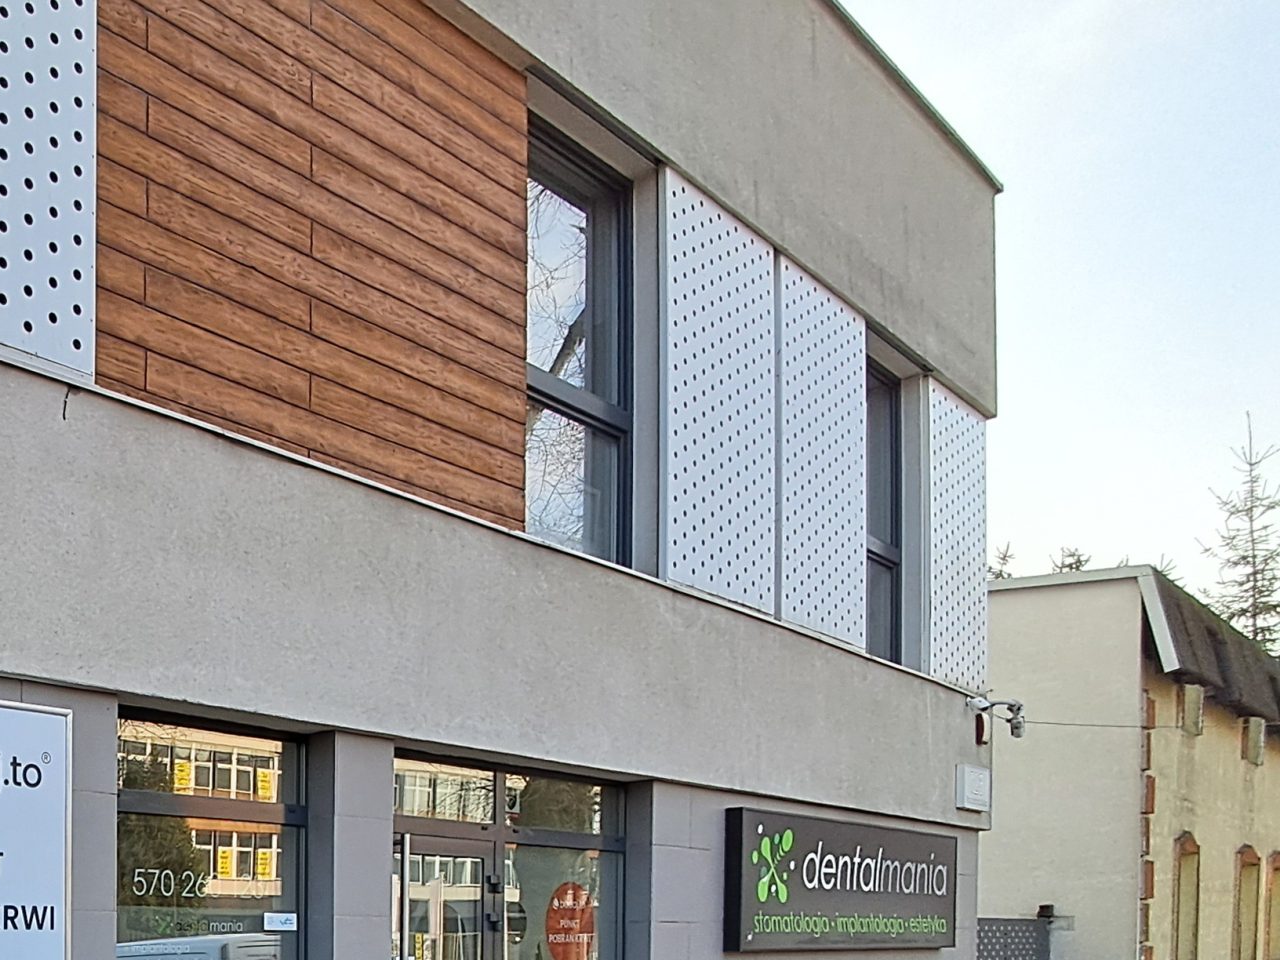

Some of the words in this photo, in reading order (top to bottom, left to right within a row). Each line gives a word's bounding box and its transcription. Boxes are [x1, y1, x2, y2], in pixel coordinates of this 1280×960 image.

[132, 868, 174, 897] 570
[802, 841, 947, 896] dentalmania
[753, 910, 830, 937] stomatologia
[835, 912, 905, 938] implantologia
[909, 914, 947, 936] estetyka
